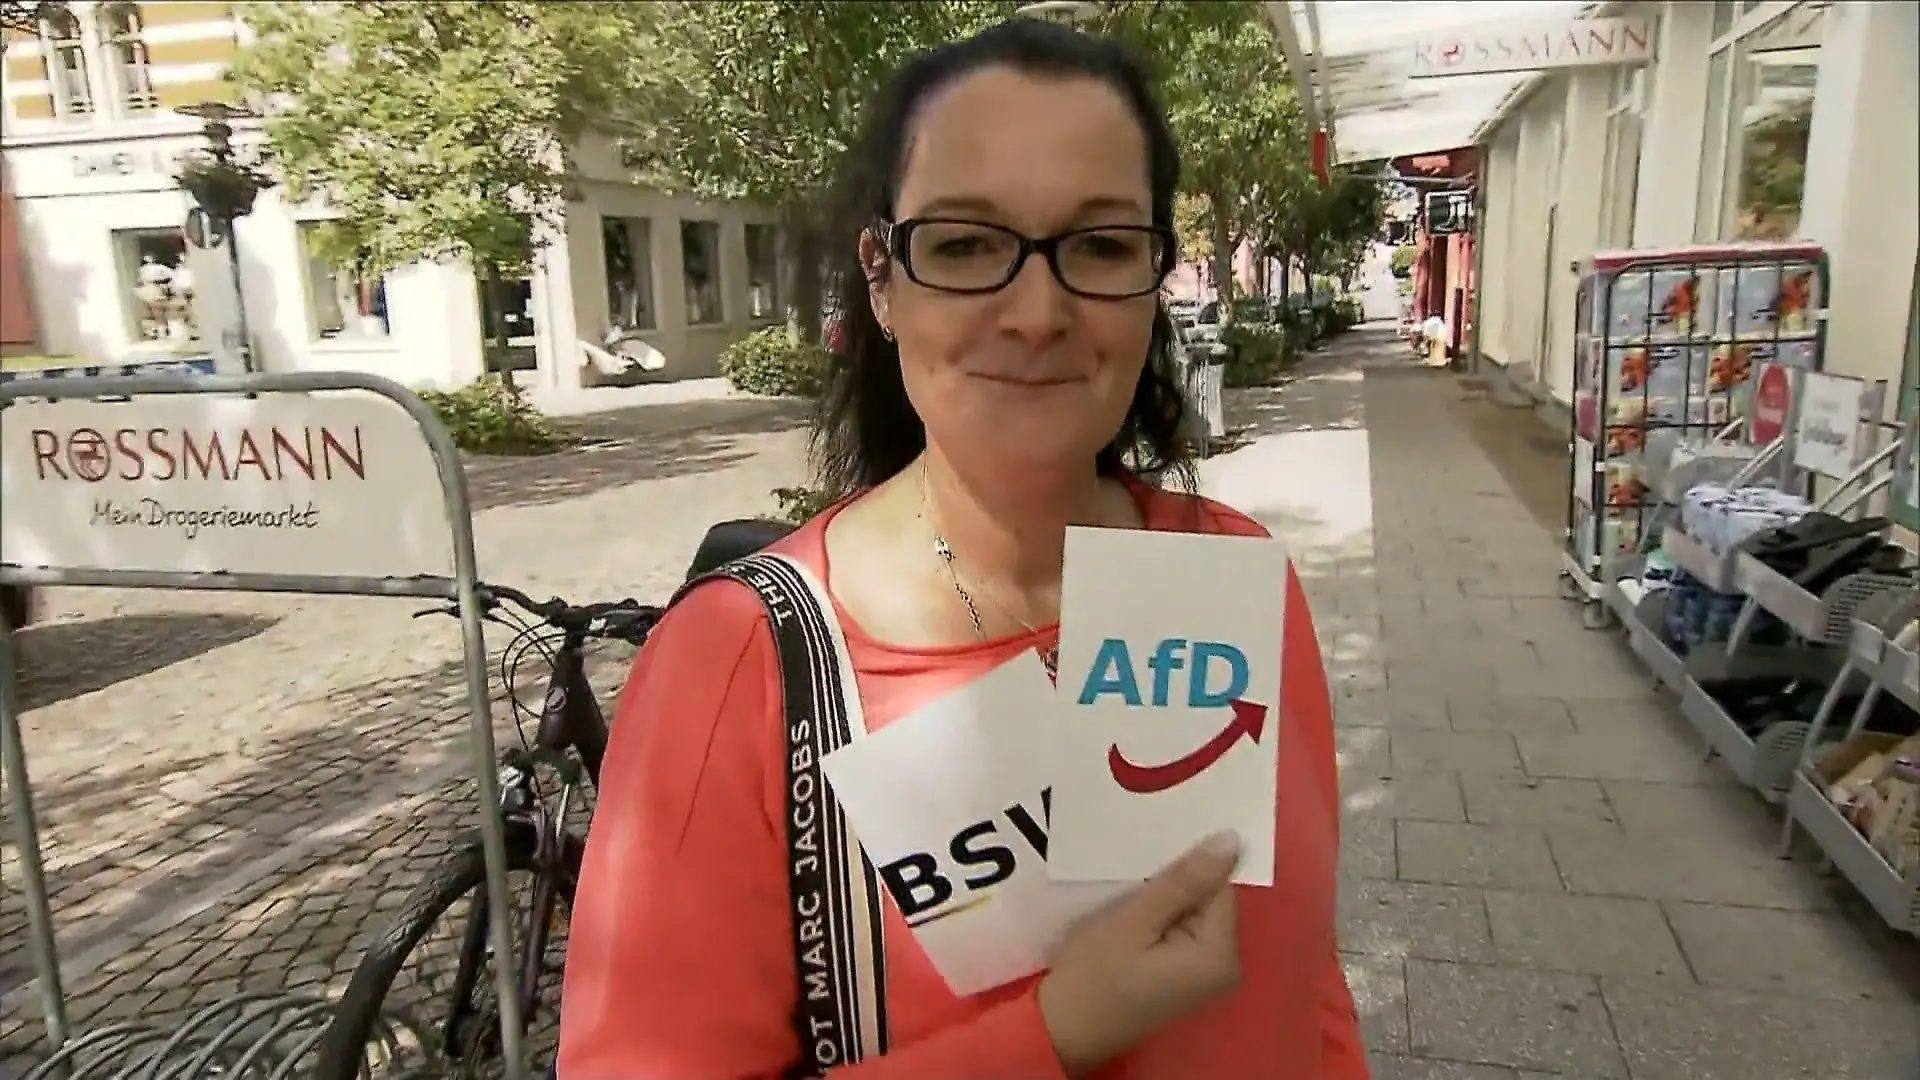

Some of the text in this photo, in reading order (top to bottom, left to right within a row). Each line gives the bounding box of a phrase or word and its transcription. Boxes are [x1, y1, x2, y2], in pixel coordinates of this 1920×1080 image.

[1414, 25, 1648, 66] ROSSMANN
[32, 426, 366, 482] ROSSMANN
[141, 498, 320, 539] Drogeriemarkt
[1077, 638, 1251, 708] AfD
[747, 573, 838, 1074] OT MARC JACOBS THE
